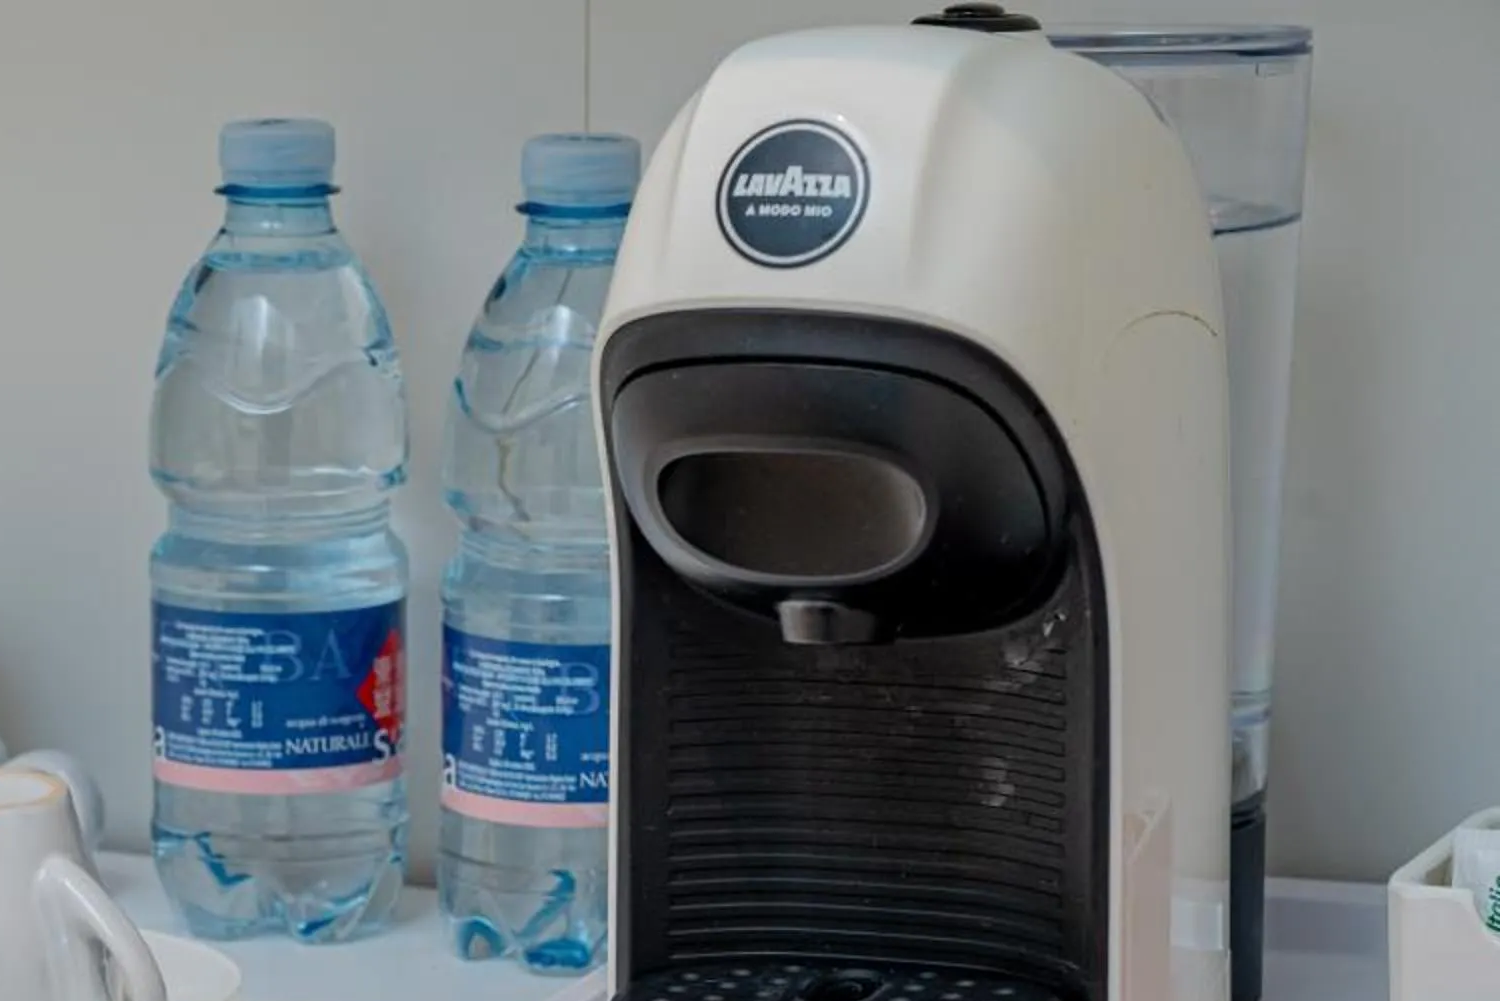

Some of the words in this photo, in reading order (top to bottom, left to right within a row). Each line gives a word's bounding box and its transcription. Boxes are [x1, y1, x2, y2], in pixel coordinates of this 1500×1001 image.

[732, 165, 851, 198] LAVAZZA
[745, 204, 756, 217] A
[758, 204, 801, 217] MODO
[804, 205, 833, 218] MIO
